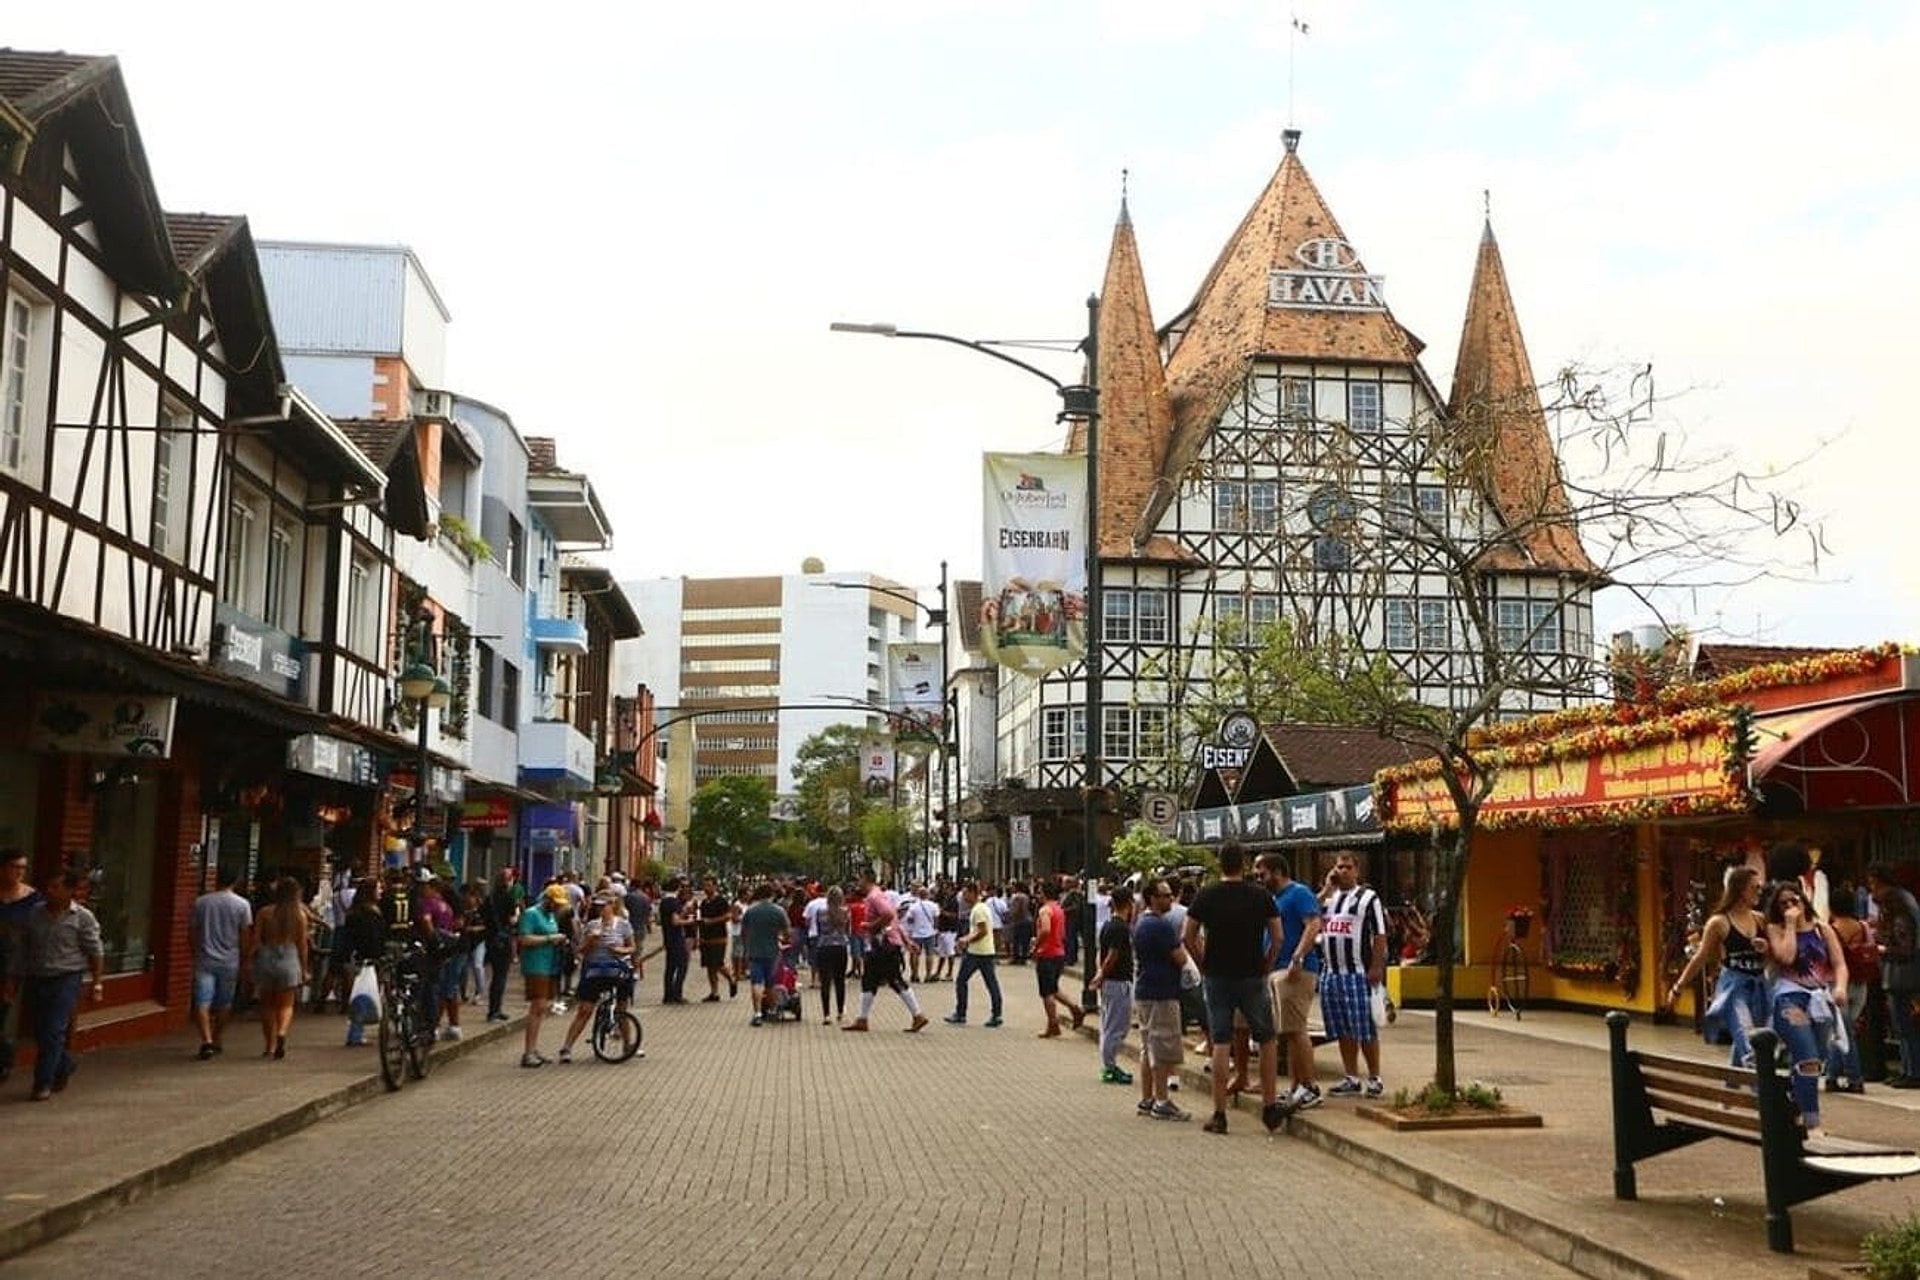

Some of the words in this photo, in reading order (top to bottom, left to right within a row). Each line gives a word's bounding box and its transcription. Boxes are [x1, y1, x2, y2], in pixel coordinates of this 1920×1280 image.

[1268, 276, 1385, 307] HAVAN
[999, 528, 1070, 551] EISENBAHN
[1153, 800, 1167, 819] E
[394, 900, 409, 923] 11
